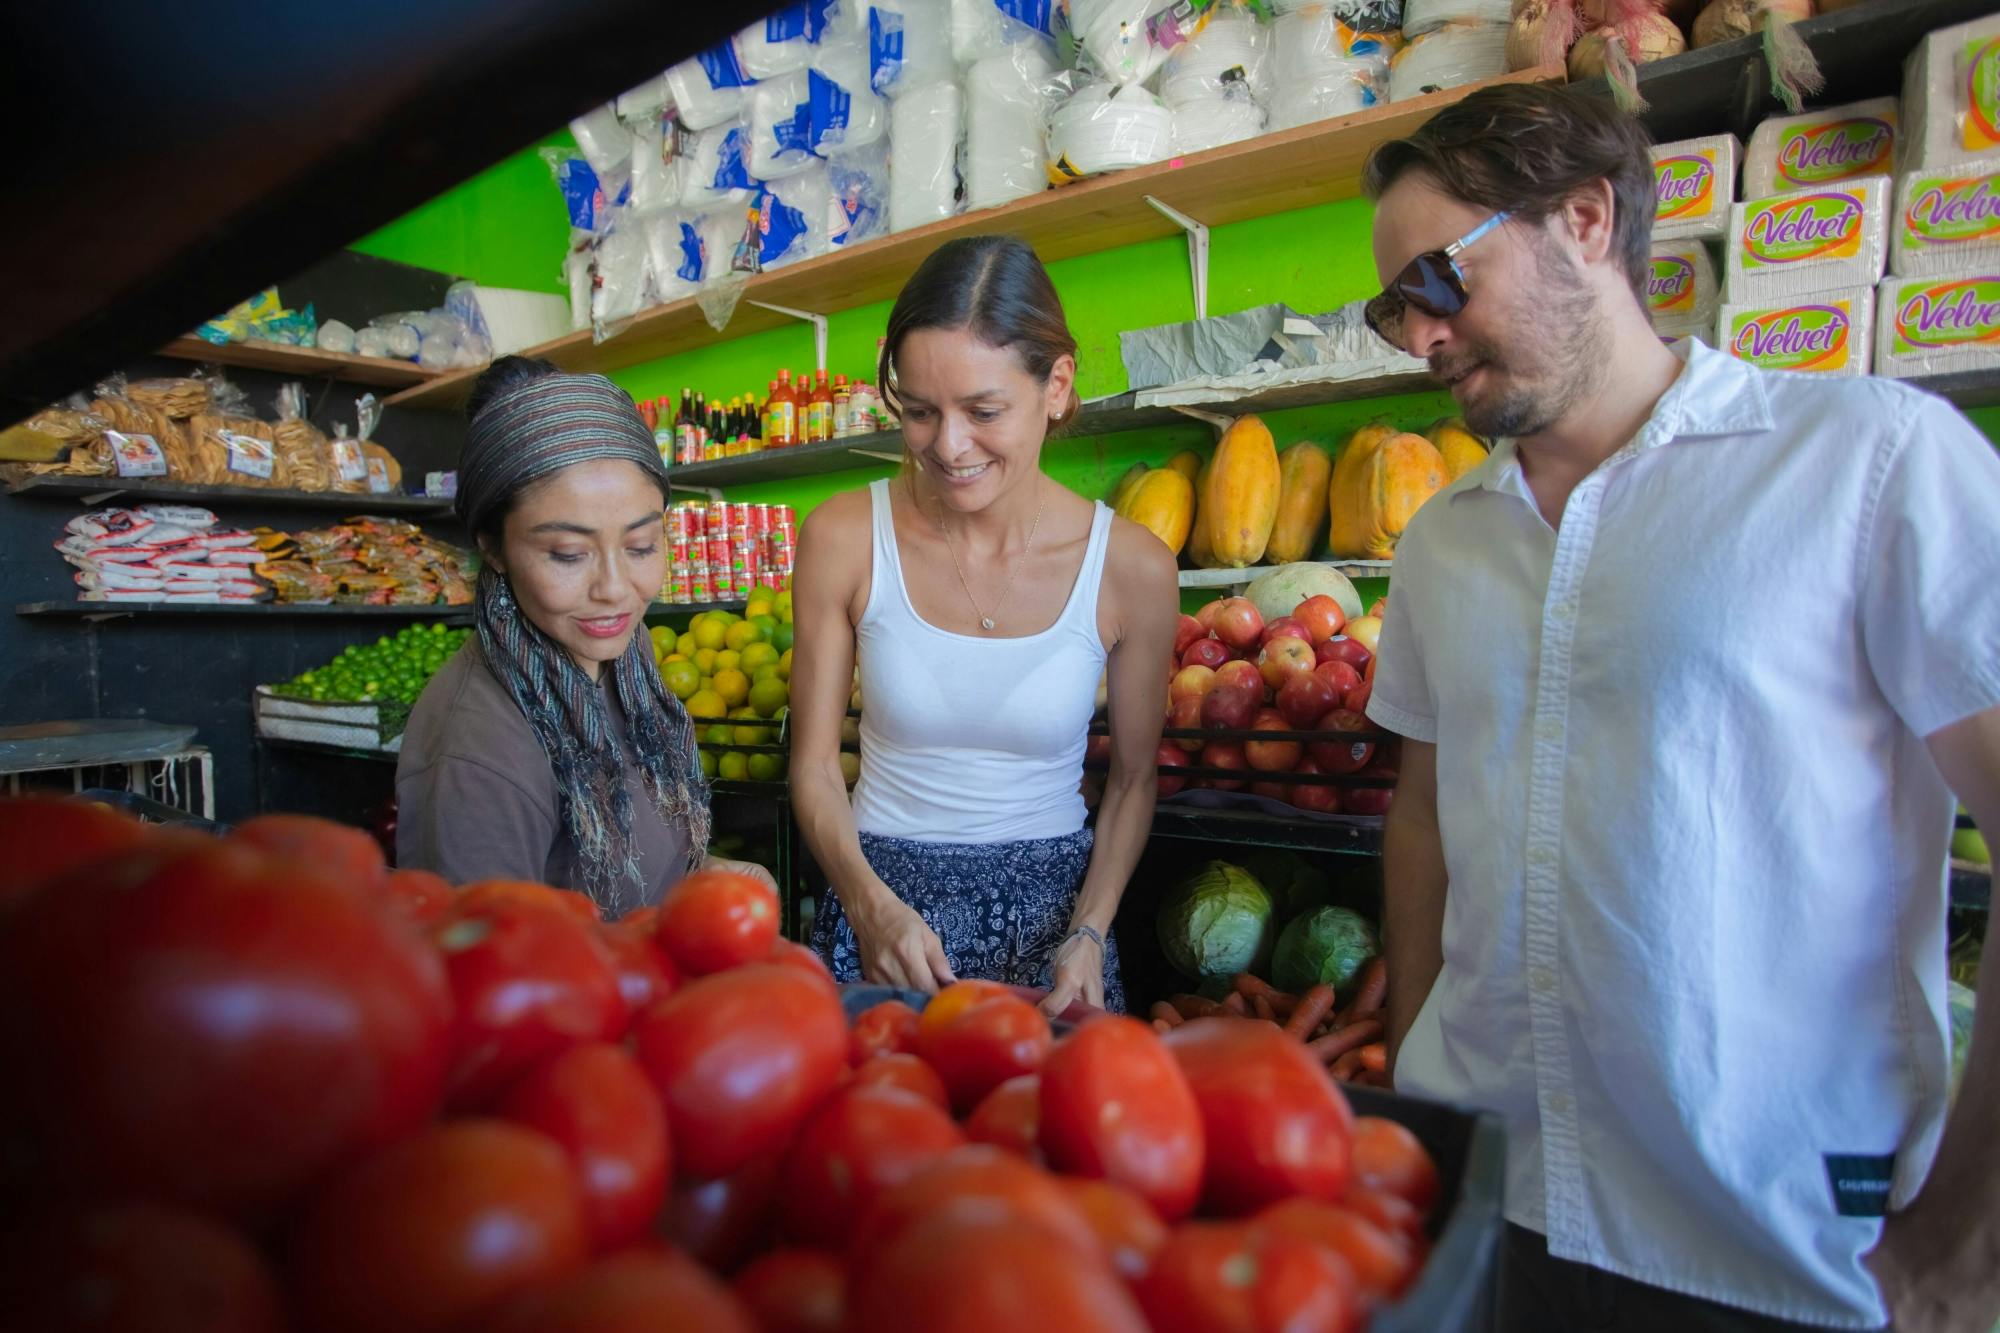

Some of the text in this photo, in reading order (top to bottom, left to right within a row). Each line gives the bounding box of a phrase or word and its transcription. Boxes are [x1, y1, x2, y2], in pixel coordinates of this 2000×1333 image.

[1782, 127, 1888, 169] Velvet
[1657, 165, 1708, 201] lvet
[1748, 204, 1858, 246] Velvet
[1901, 290, 2000, 331] Velve
[1736, 316, 1843, 357] Velvet
